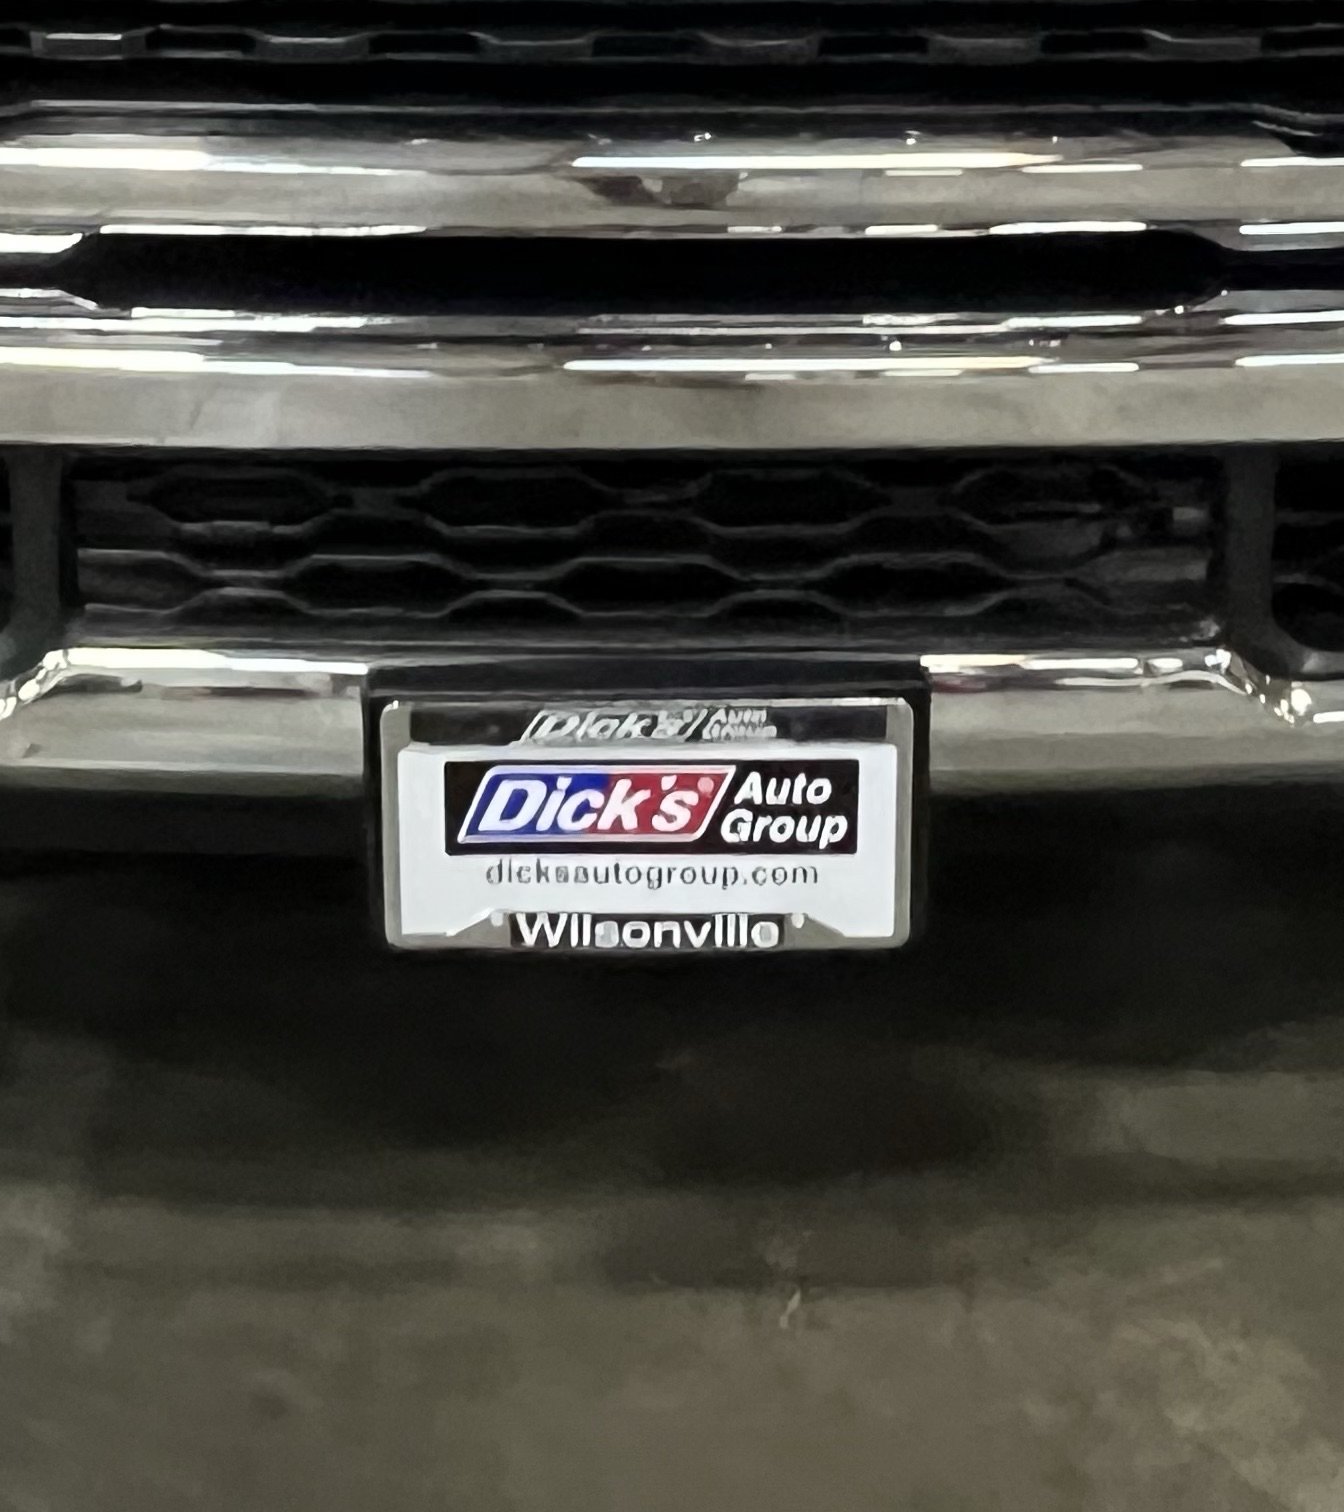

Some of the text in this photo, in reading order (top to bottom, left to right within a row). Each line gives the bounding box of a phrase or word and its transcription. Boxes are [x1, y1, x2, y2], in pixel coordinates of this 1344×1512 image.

[734, 771, 833, 806] Auto
[721, 808, 848, 850] Group
[485, 859, 820, 890] dicksautogroup.com
[515, 912, 780, 949] Wilsonville
